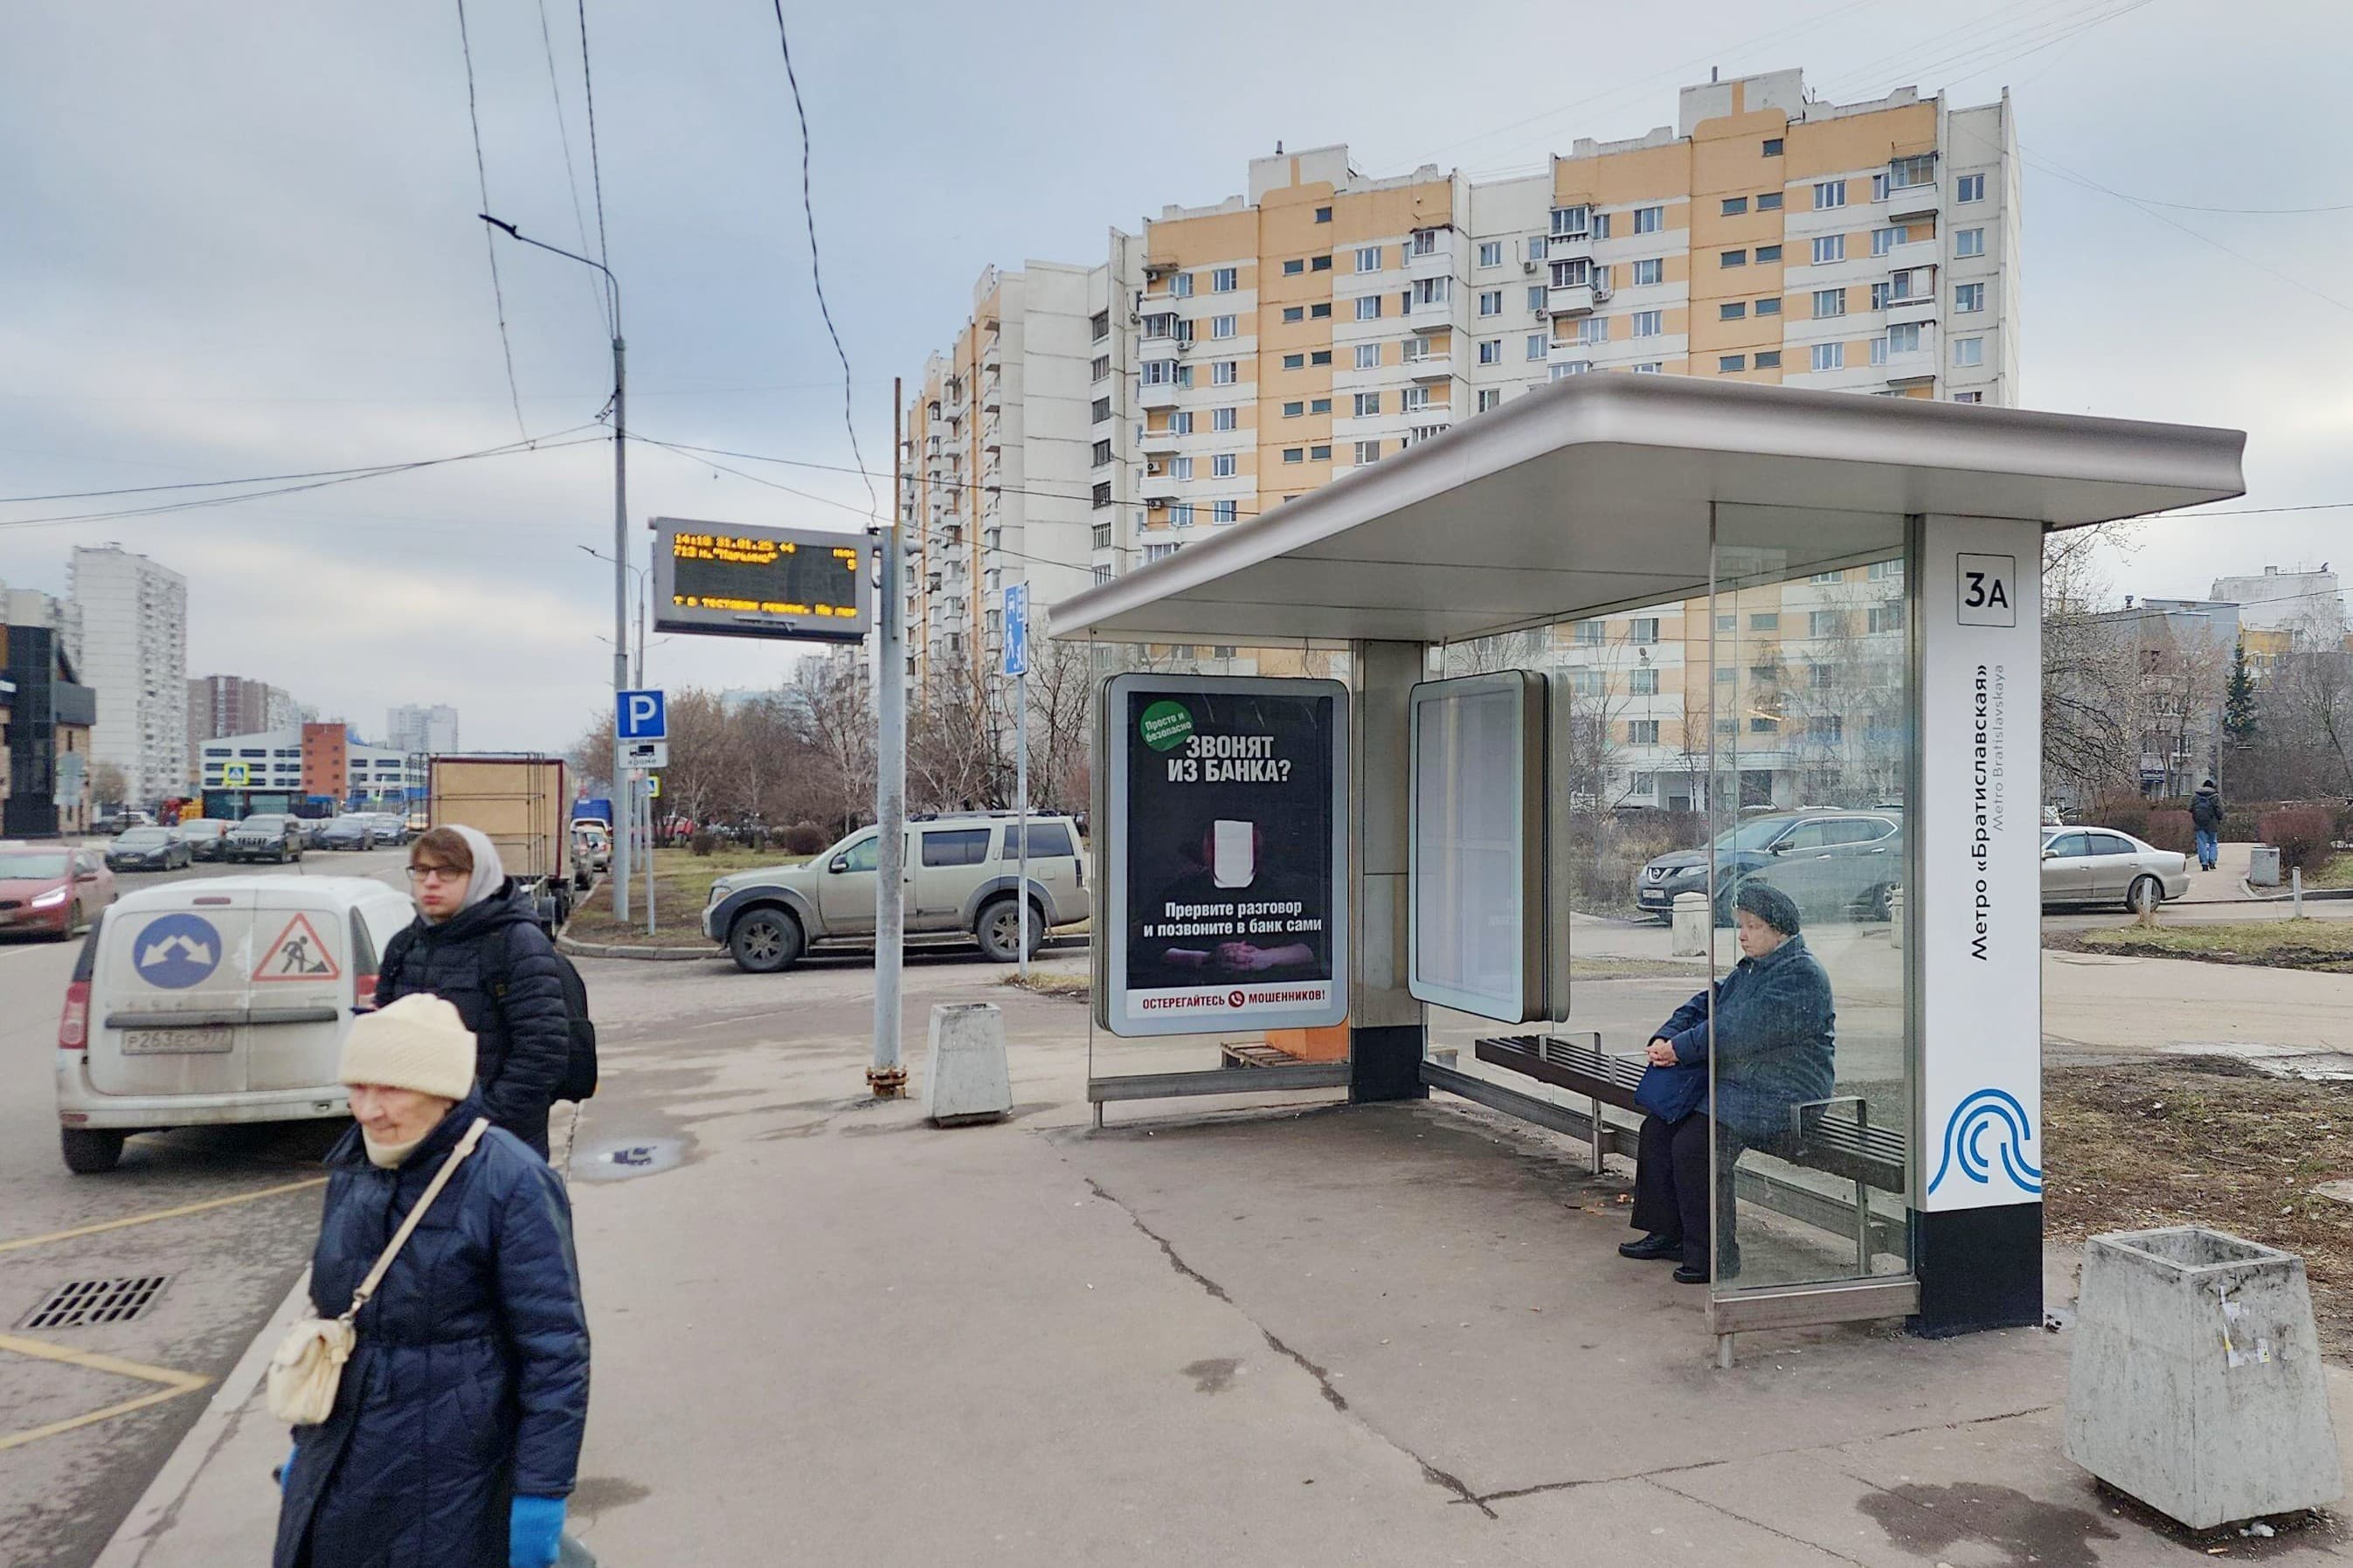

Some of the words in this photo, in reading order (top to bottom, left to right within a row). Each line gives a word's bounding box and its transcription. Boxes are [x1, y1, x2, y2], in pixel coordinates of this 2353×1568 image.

[1145, 715, 1177, 732] Просто
[1178, 712, 1185, 721] и
[1145, 722, 1192, 743] безопасно
[1992, 665, 2006, 777] Bratislavskaya
[1186, 735, 1275, 758] ЗВОНЯТ
[1167, 758, 1199, 782] ИЗ
[1205, 758, 1291, 782] БАНКА?
[1971, 665, 1990, 872] «Братиславская»
[1992, 782, 2005, 832] Metro
[1166, 901, 1233, 919] Прервите
[1237, 901, 1302, 917] разговор
[1971, 879, 1990, 961] Метро
[1143, 924, 1152, 937] и
[1157, 922, 1233, 939] позвоните
[1236, 922, 1246, 934] в
[1249, 918, 1283, 934] банк
[1286, 918, 1322, 933] сами
[1142, 994, 1225, 1010] ОСТЕРЕГАЙТЕСЬ
[1249, 989, 1325, 1005] МОШЕННИКОВ!
